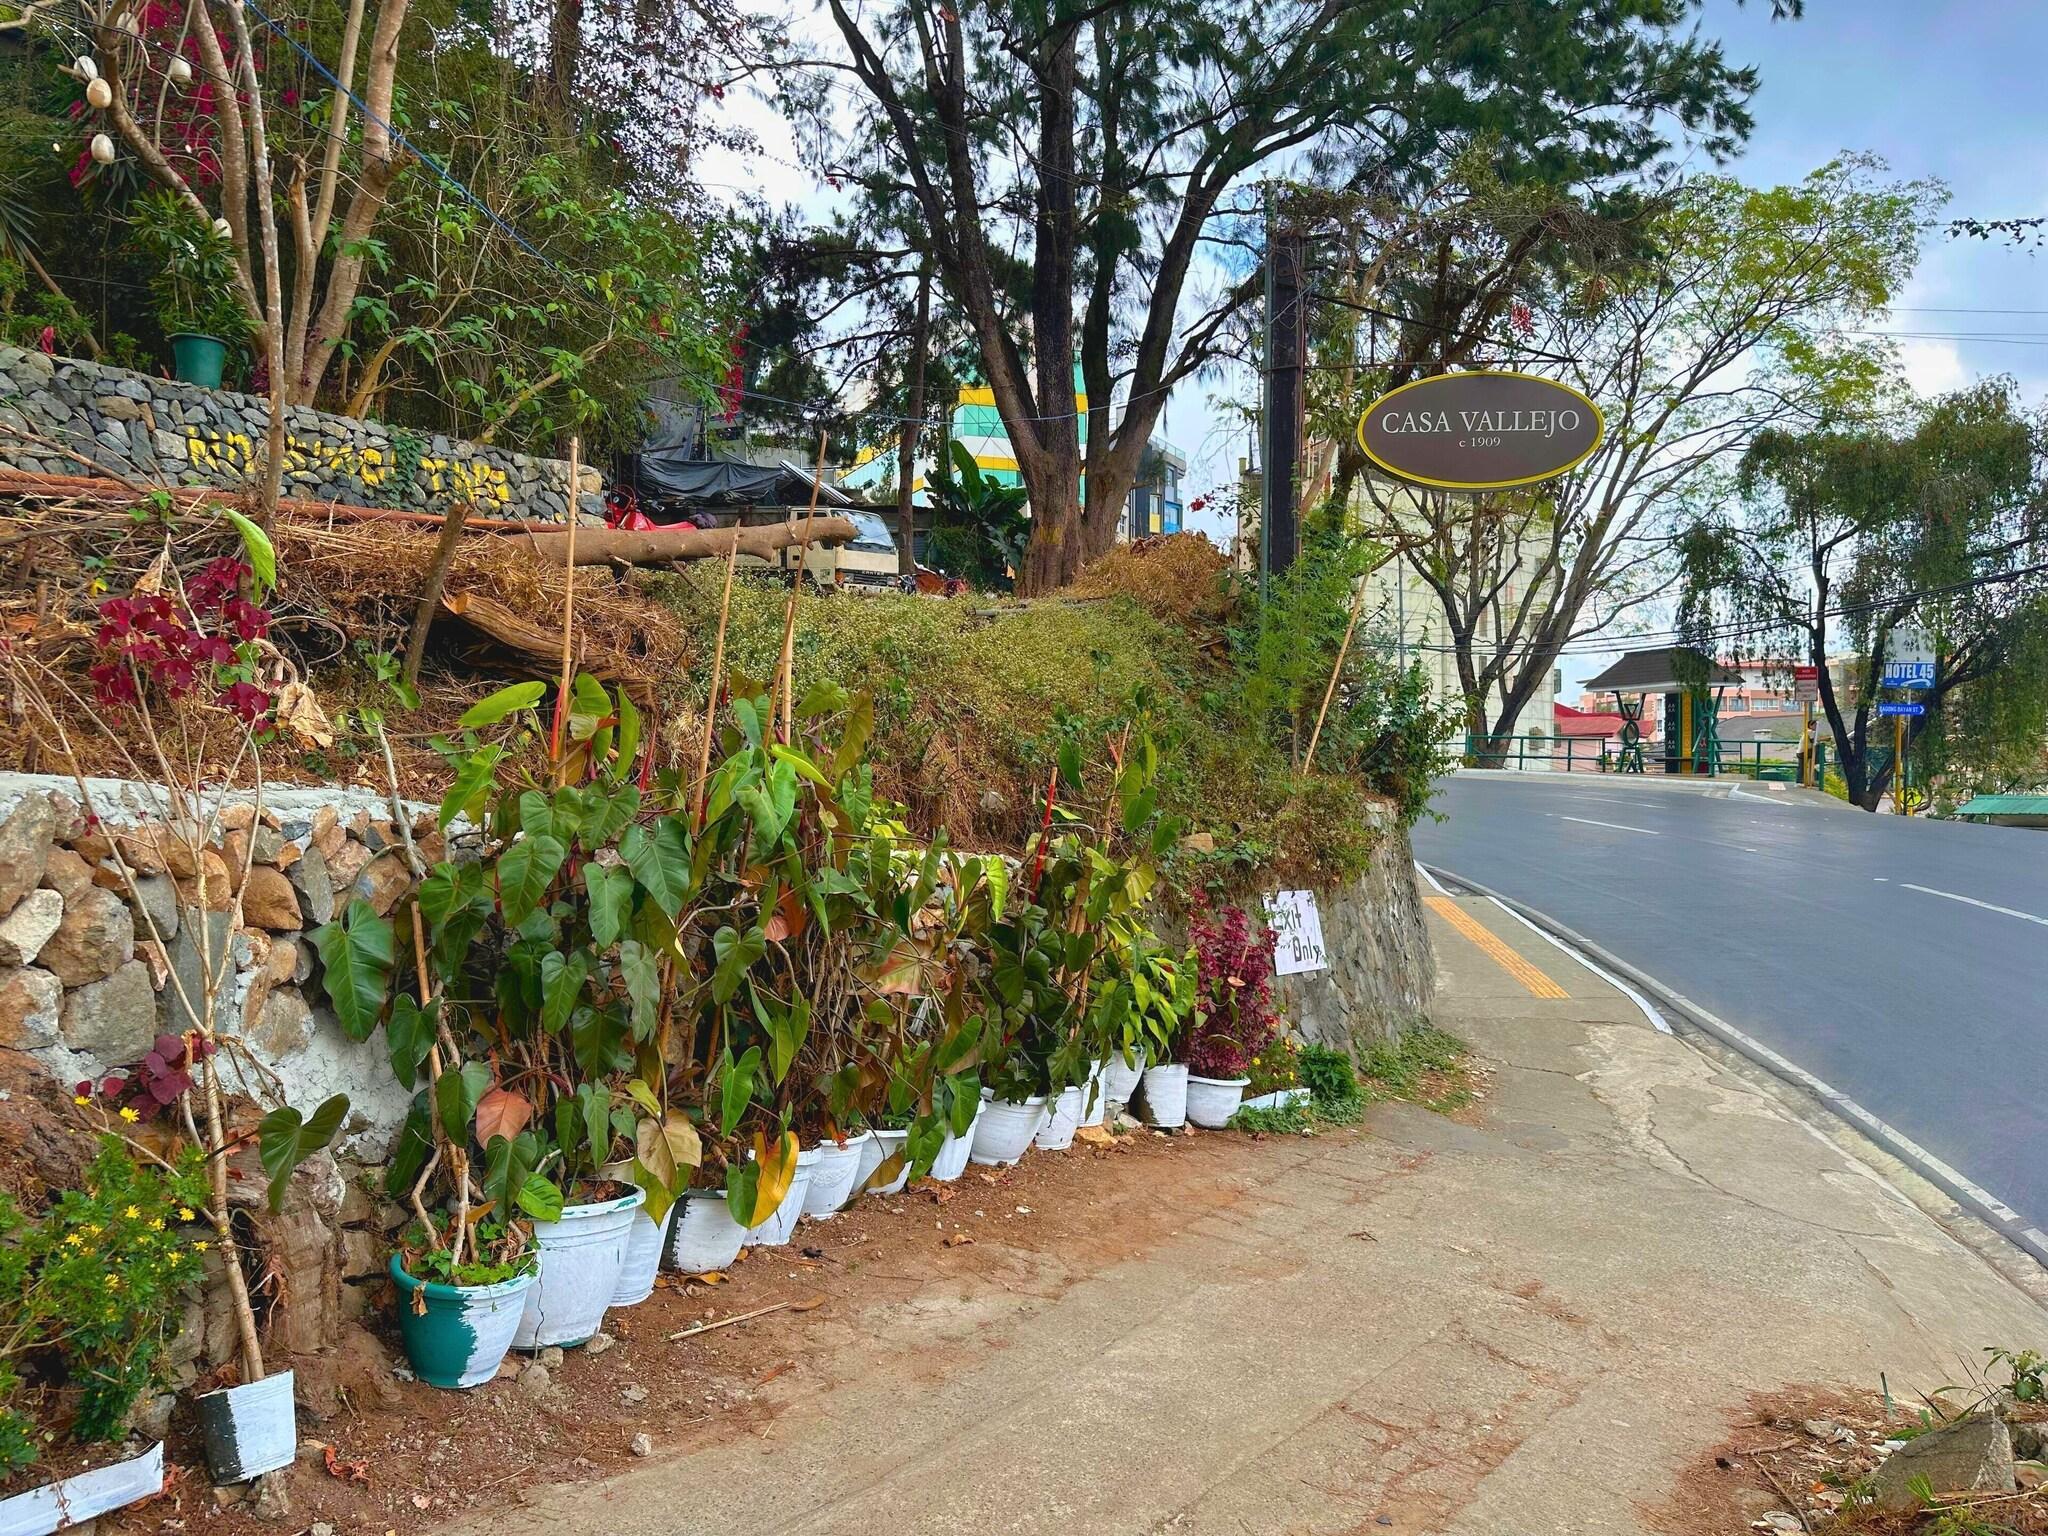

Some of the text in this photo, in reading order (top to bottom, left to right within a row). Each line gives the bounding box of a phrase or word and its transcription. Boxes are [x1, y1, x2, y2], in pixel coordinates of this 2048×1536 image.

[1382, 410, 1580, 438] CASA VALLEJO
[1471, 437, 1501, 448] 1909
[1885, 663, 1934, 679] HOTEL 45
[1292, 935, 1322, 964] Only
